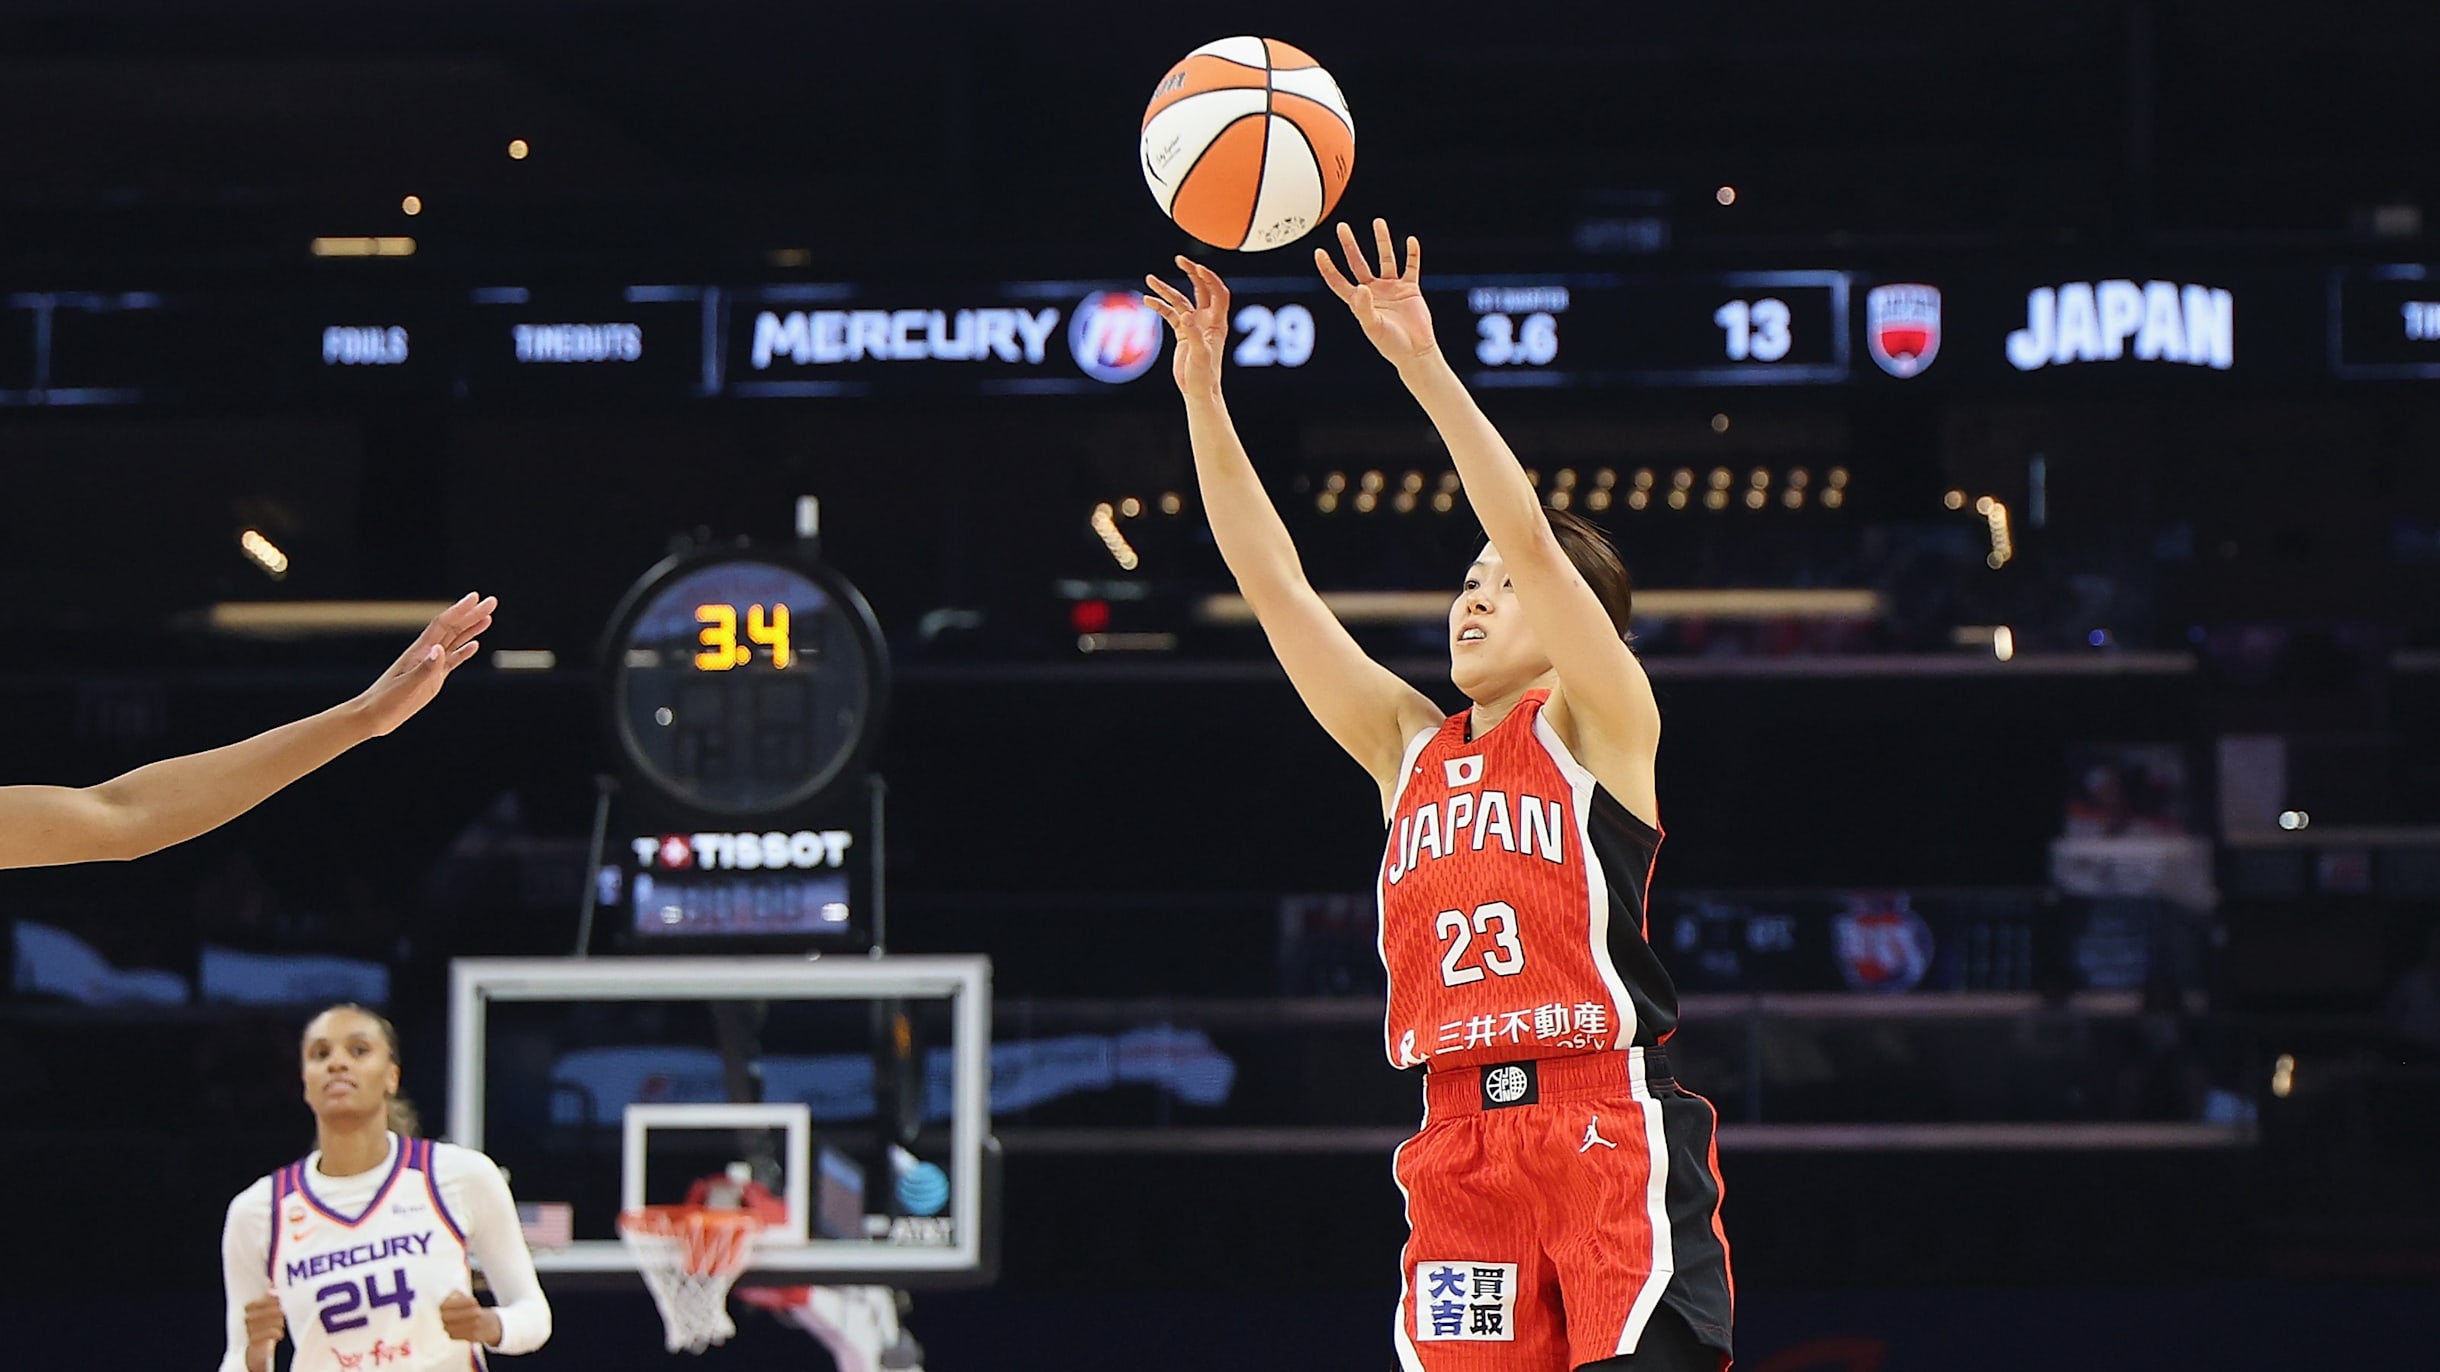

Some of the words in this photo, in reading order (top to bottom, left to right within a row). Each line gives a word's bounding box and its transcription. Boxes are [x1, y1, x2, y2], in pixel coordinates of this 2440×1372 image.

[323, 326, 408, 364] FOULS
[513, 323, 642, 362] TIMEOUTS
[752, 308, 1060, 368] MERCURY
[1232, 304, 1315, 367] 29
[1475, 312, 1558, 366] 3.6
[1715, 299, 1791, 361] 13
[2006, 280, 2233, 370] JAPAN
[694, 603, 790, 671] 3.4
[692, 831, 852, 869] TISSOT
[1388, 790, 1563, 885] JAPAN
[1435, 901, 1525, 987] 23
[1435, 1001, 1608, 1055] 三井不動産
[286, 1231, 433, 1287] MERCURY
[316, 1268, 415, 1334] 24
